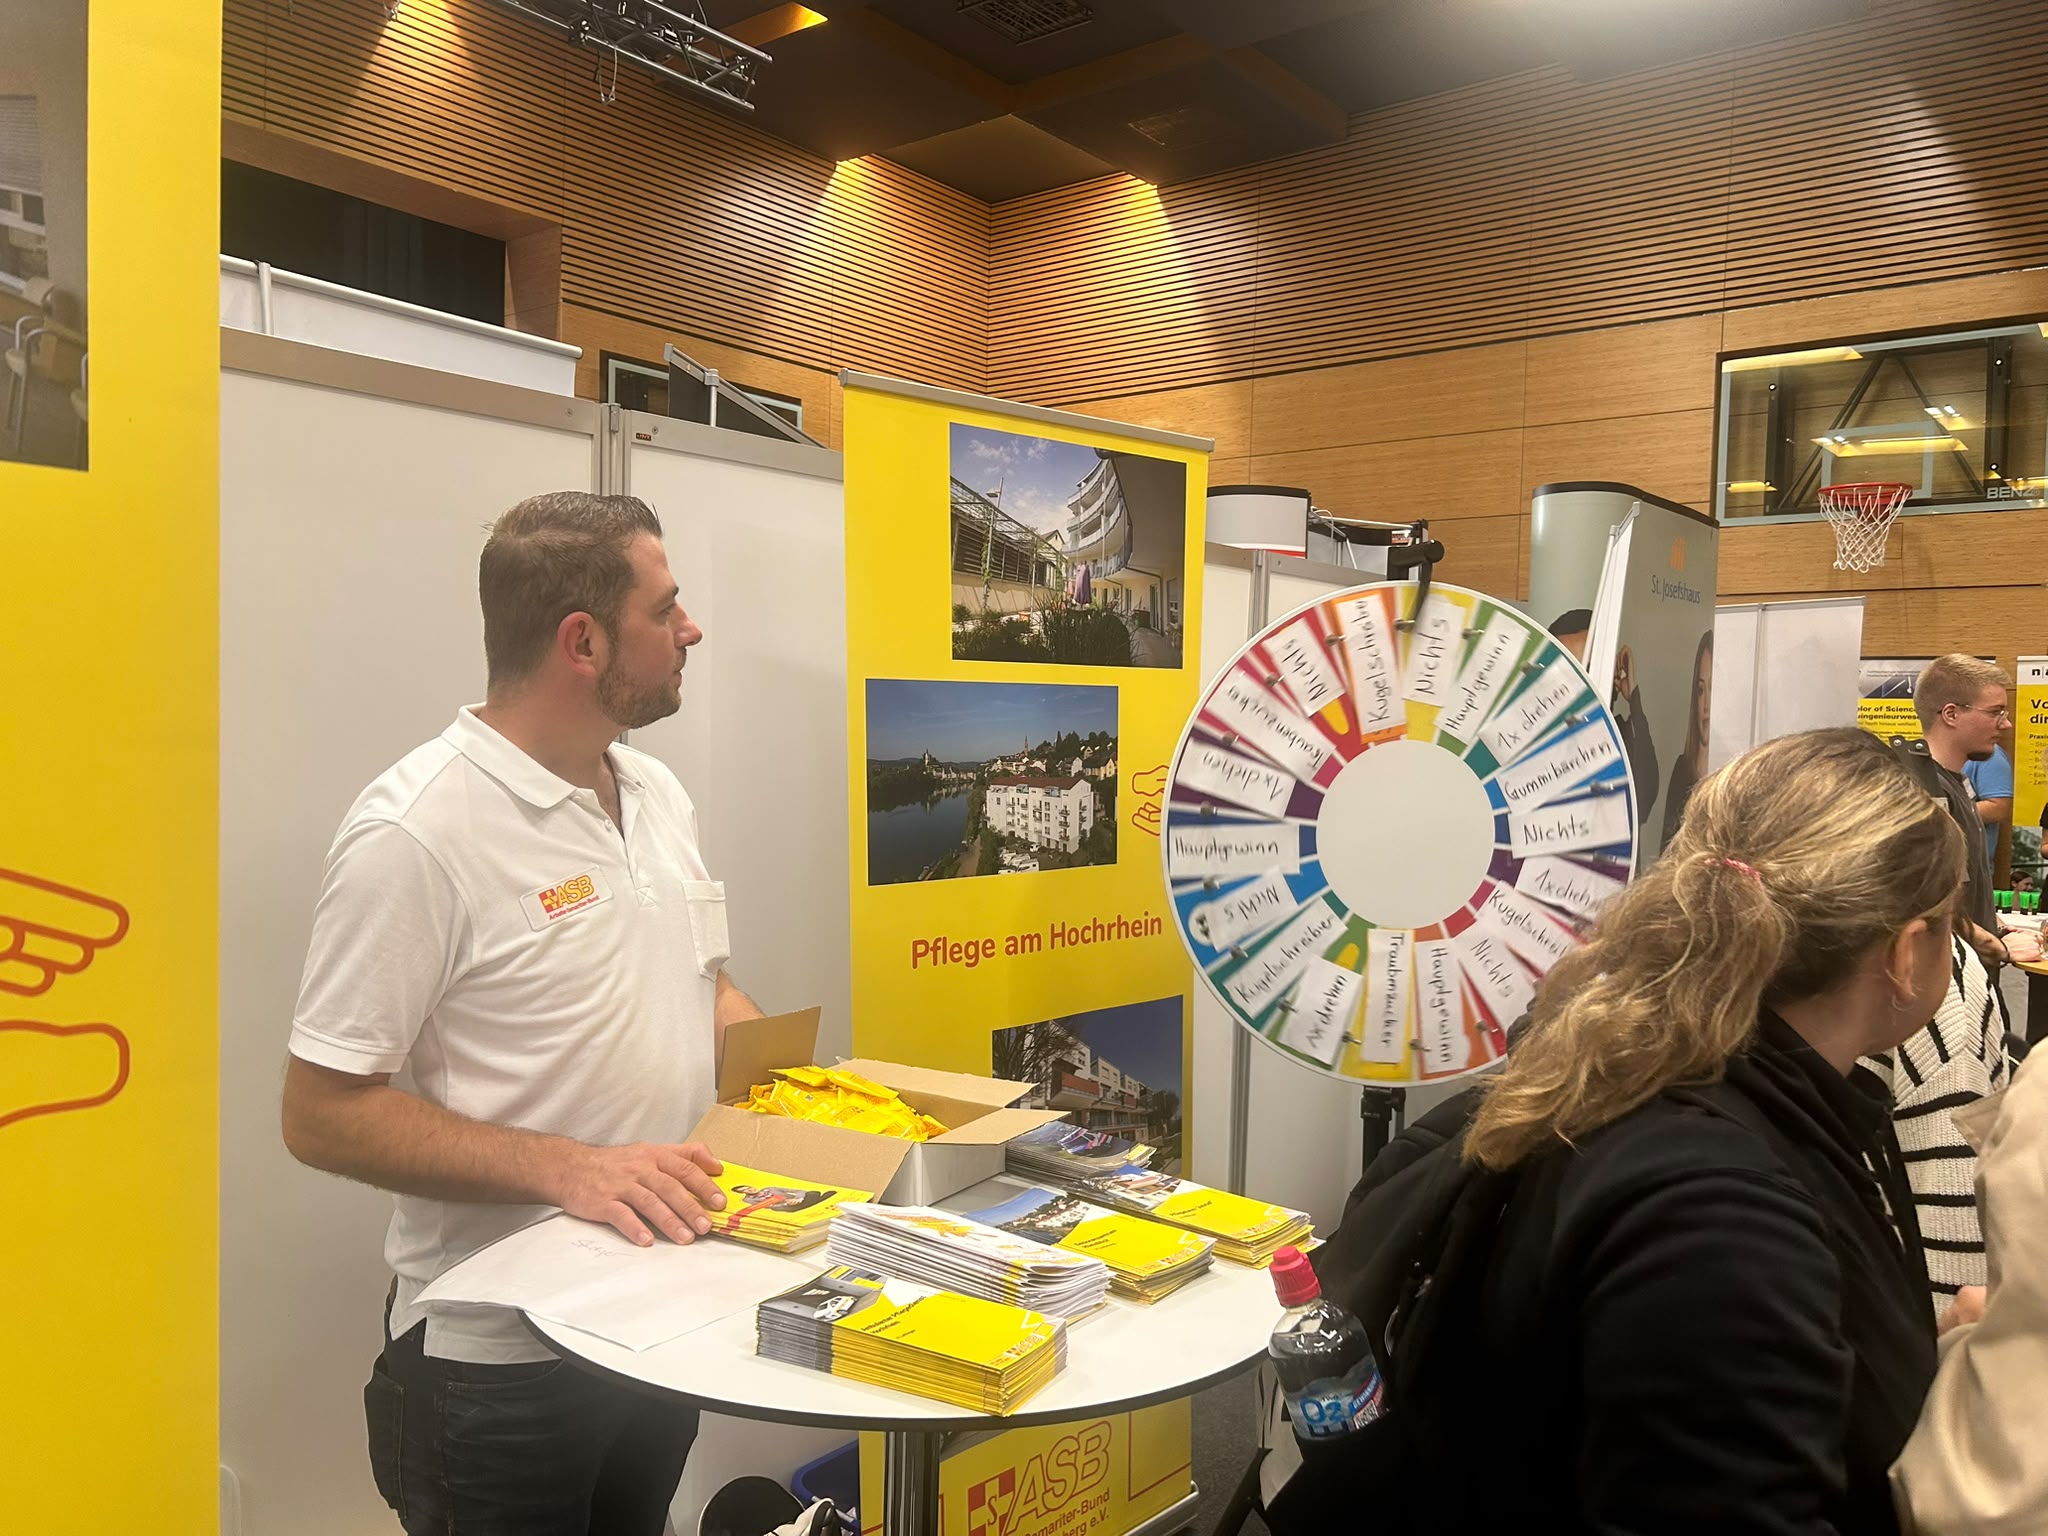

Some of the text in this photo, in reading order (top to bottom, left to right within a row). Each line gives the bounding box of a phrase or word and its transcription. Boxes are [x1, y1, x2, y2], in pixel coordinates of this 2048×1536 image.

[1986, 486, 2035, 499] BENZ
[1651, 574, 1701, 604] St. Josefshaus
[1282, 638, 1330, 702] Nichts
[1414, 618, 1450, 695] Nichts
[1446, 634, 1512, 731] Hauptgewinn
[1521, 683, 1571, 728] drehen
[1228, 684, 1325, 769] Traubenzucker
[1203, 750, 1260, 790] drehen
[1504, 741, 1613, 801] Gummibärchen
[1175, 836, 1279, 862] Hauptgewinn
[1523, 814, 1589, 845] Nichts
[555, 875, 594, 909] ASB
[1224, 884, 1280, 922] Nichts
[1556, 875, 1601, 911] dreh
[912, 911, 1162, 969] Pflege am Hochrhein
[1380, 933, 1406, 1049] Traubenzucker
[1472, 938, 1515, 998] Nichts
[1314, 974, 1348, 1026] drehen
[1428, 946, 1453, 1064] Hauptgewinn
[1002, 1420, 1113, 1536] ASB
[1026, 1487, 1110, 1536] mariter-Bund
[1090, 1507, 1110, 1527] e.V.
